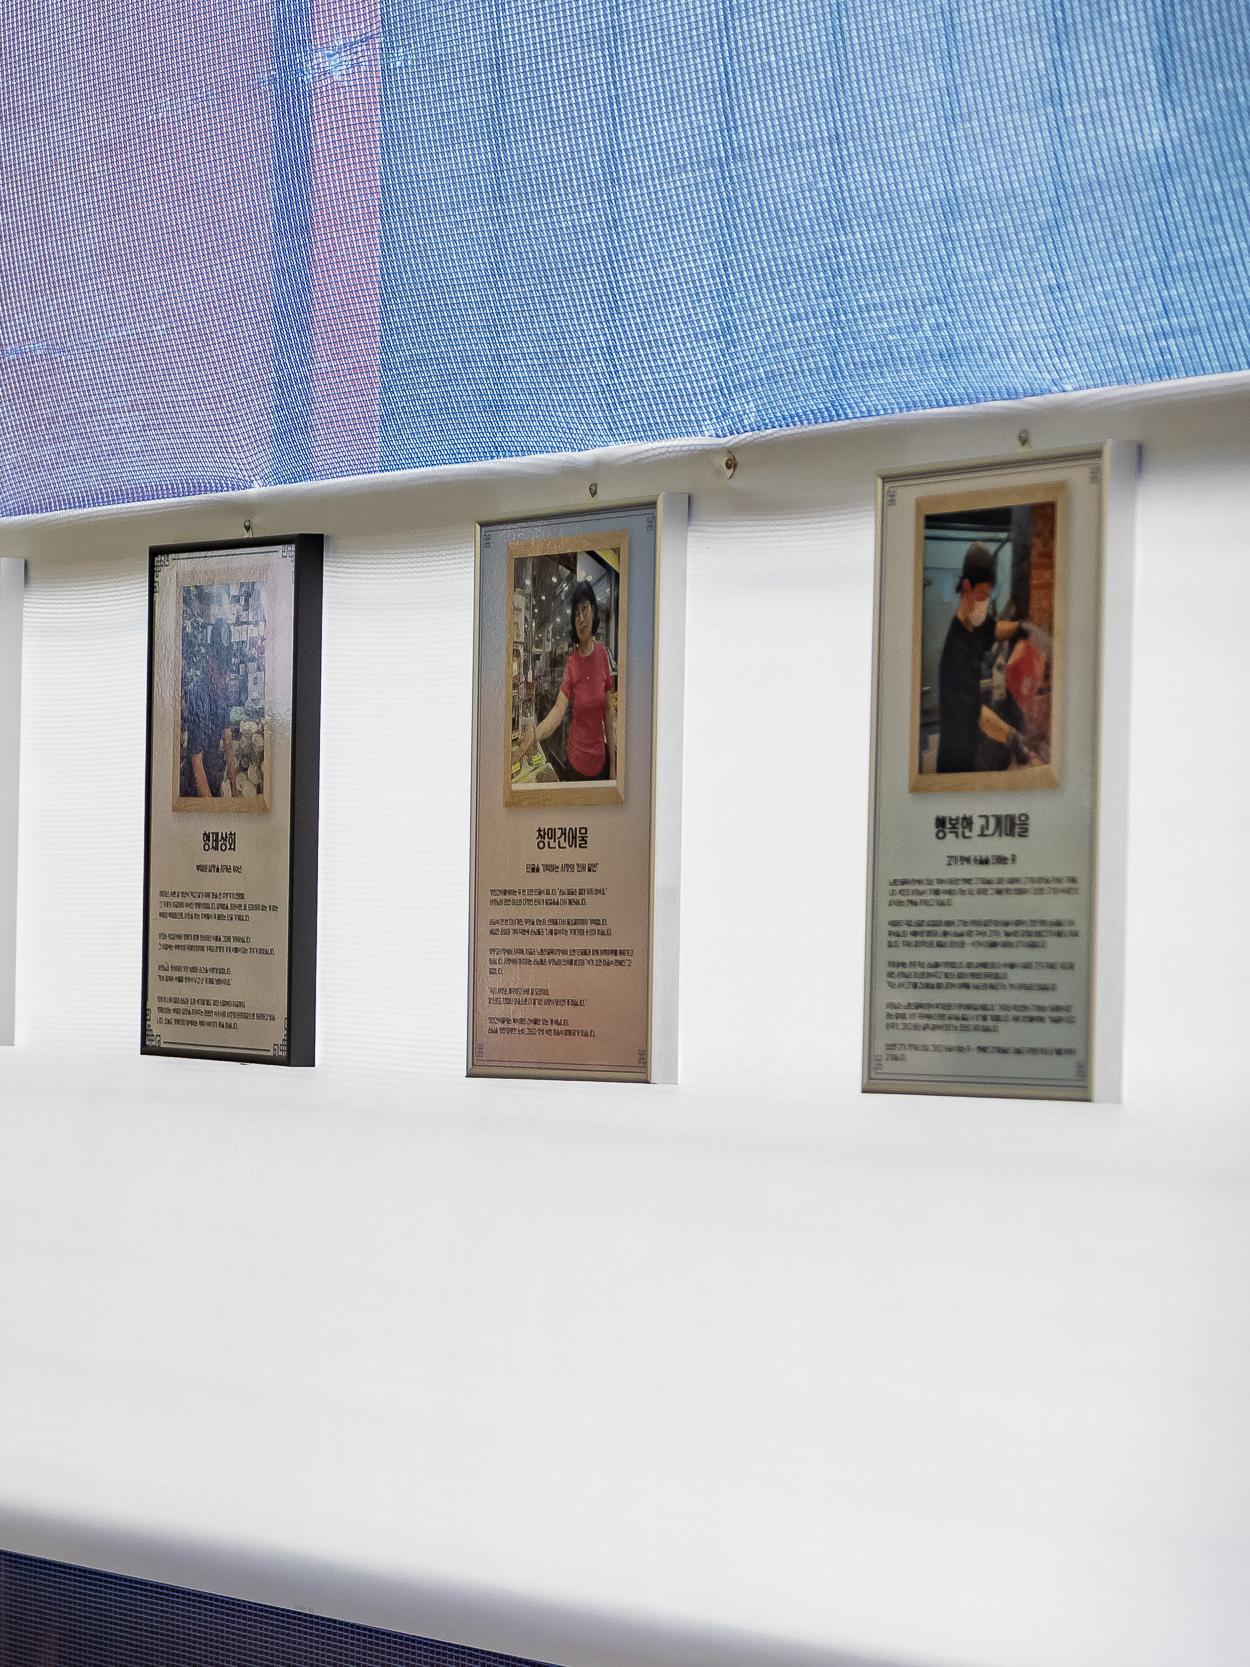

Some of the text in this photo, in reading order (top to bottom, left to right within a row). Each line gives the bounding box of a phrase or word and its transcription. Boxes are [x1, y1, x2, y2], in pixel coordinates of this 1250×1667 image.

[535, 826, 589, 850] 창민건어물
[934, 812, 1030, 840] 행복한 고기마을
[202, 831, 236, 852] 형제상회
